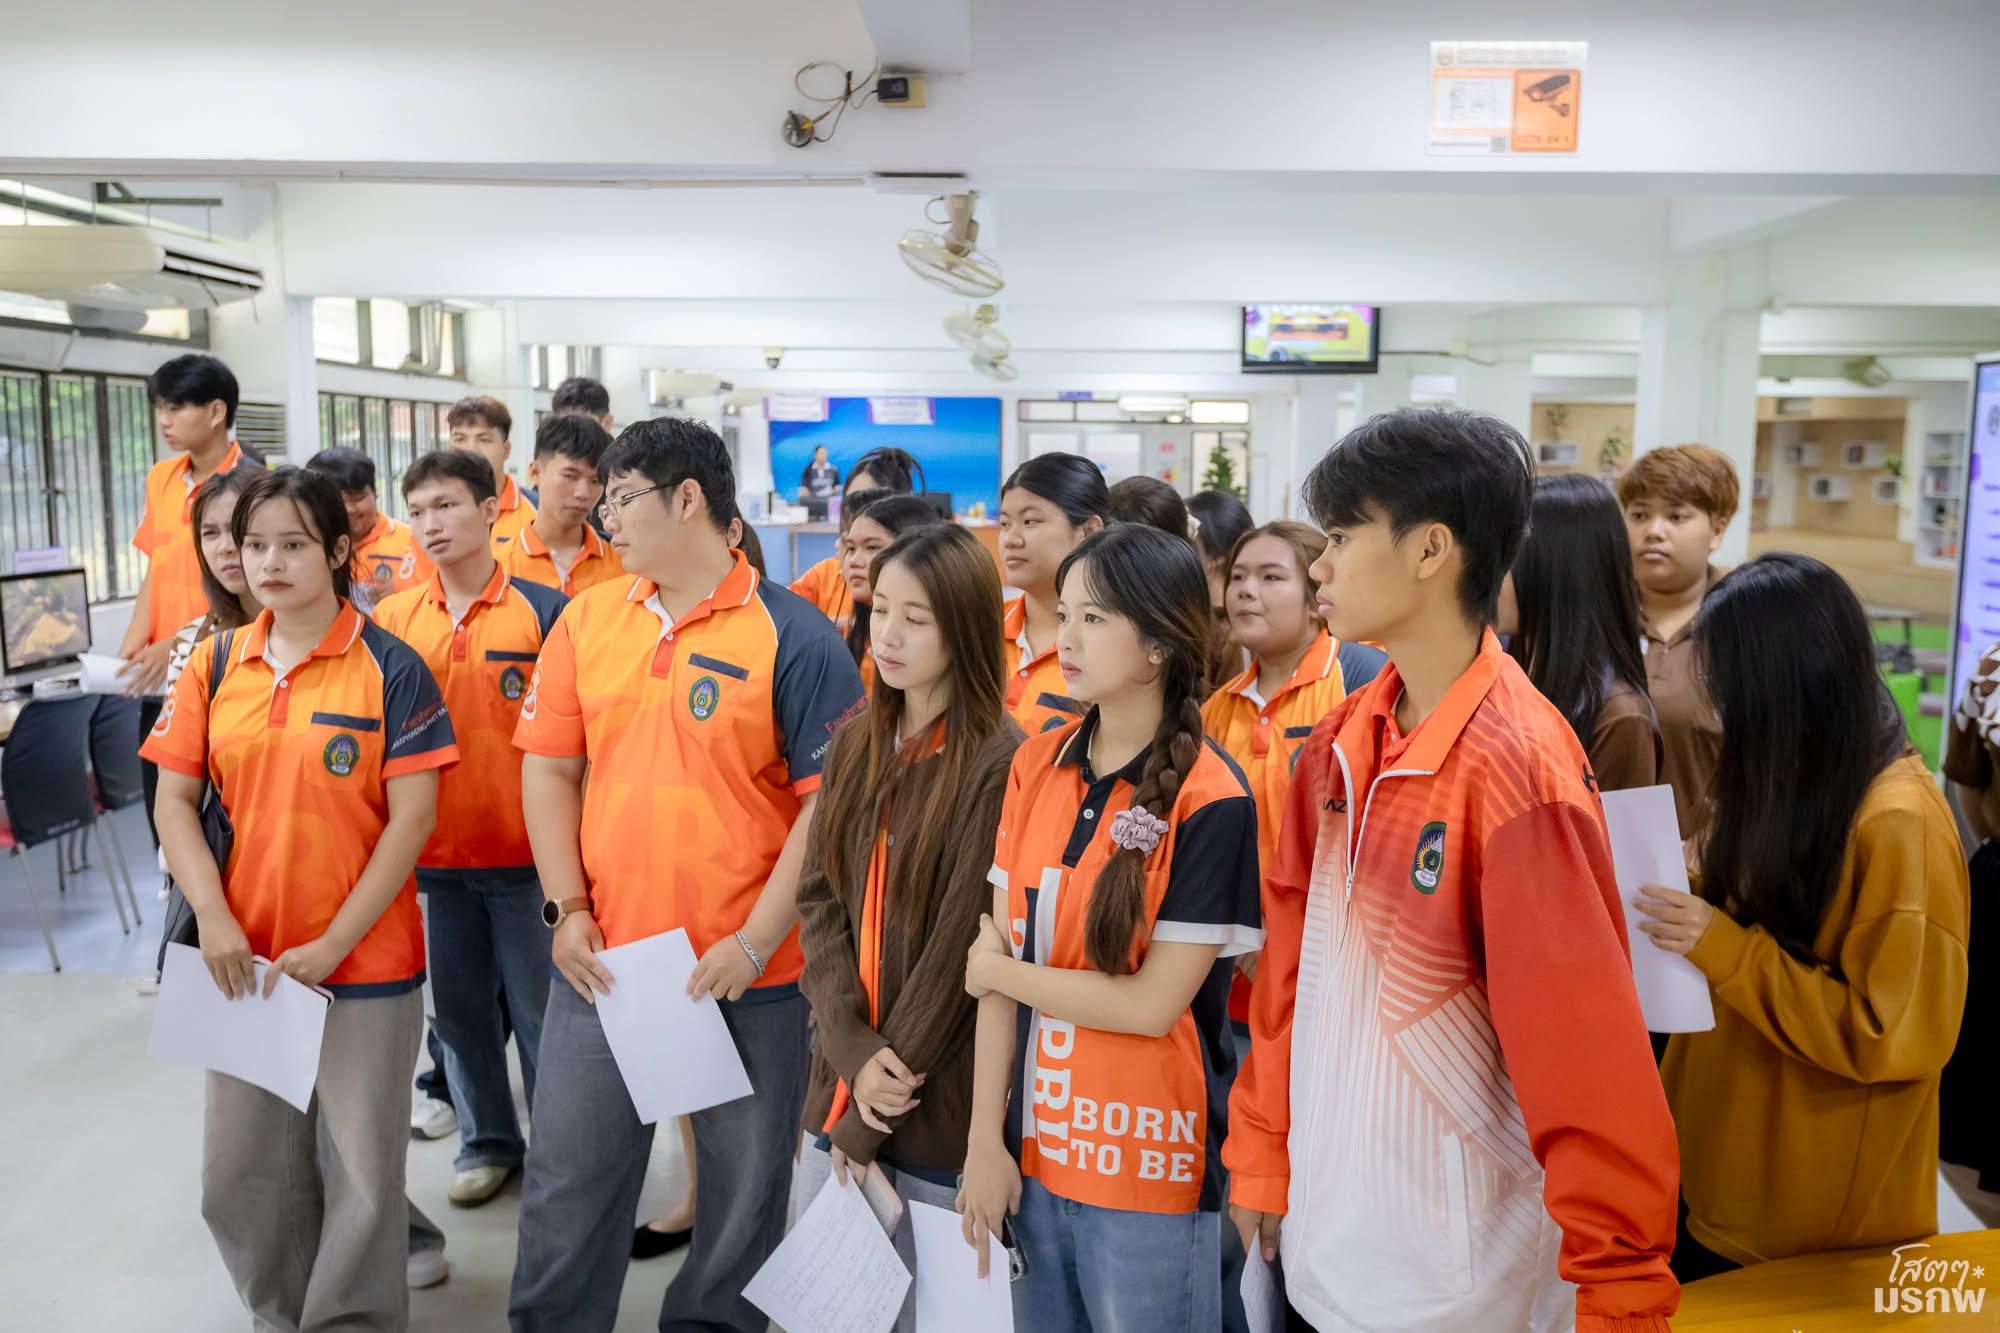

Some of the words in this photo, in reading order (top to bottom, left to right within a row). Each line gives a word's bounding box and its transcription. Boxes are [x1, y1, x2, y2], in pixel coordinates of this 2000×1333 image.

[1072, 1096, 1198, 1144] BORN
[1070, 1138, 1122, 1175] TO
[1137, 1149, 1195, 1182] BE
